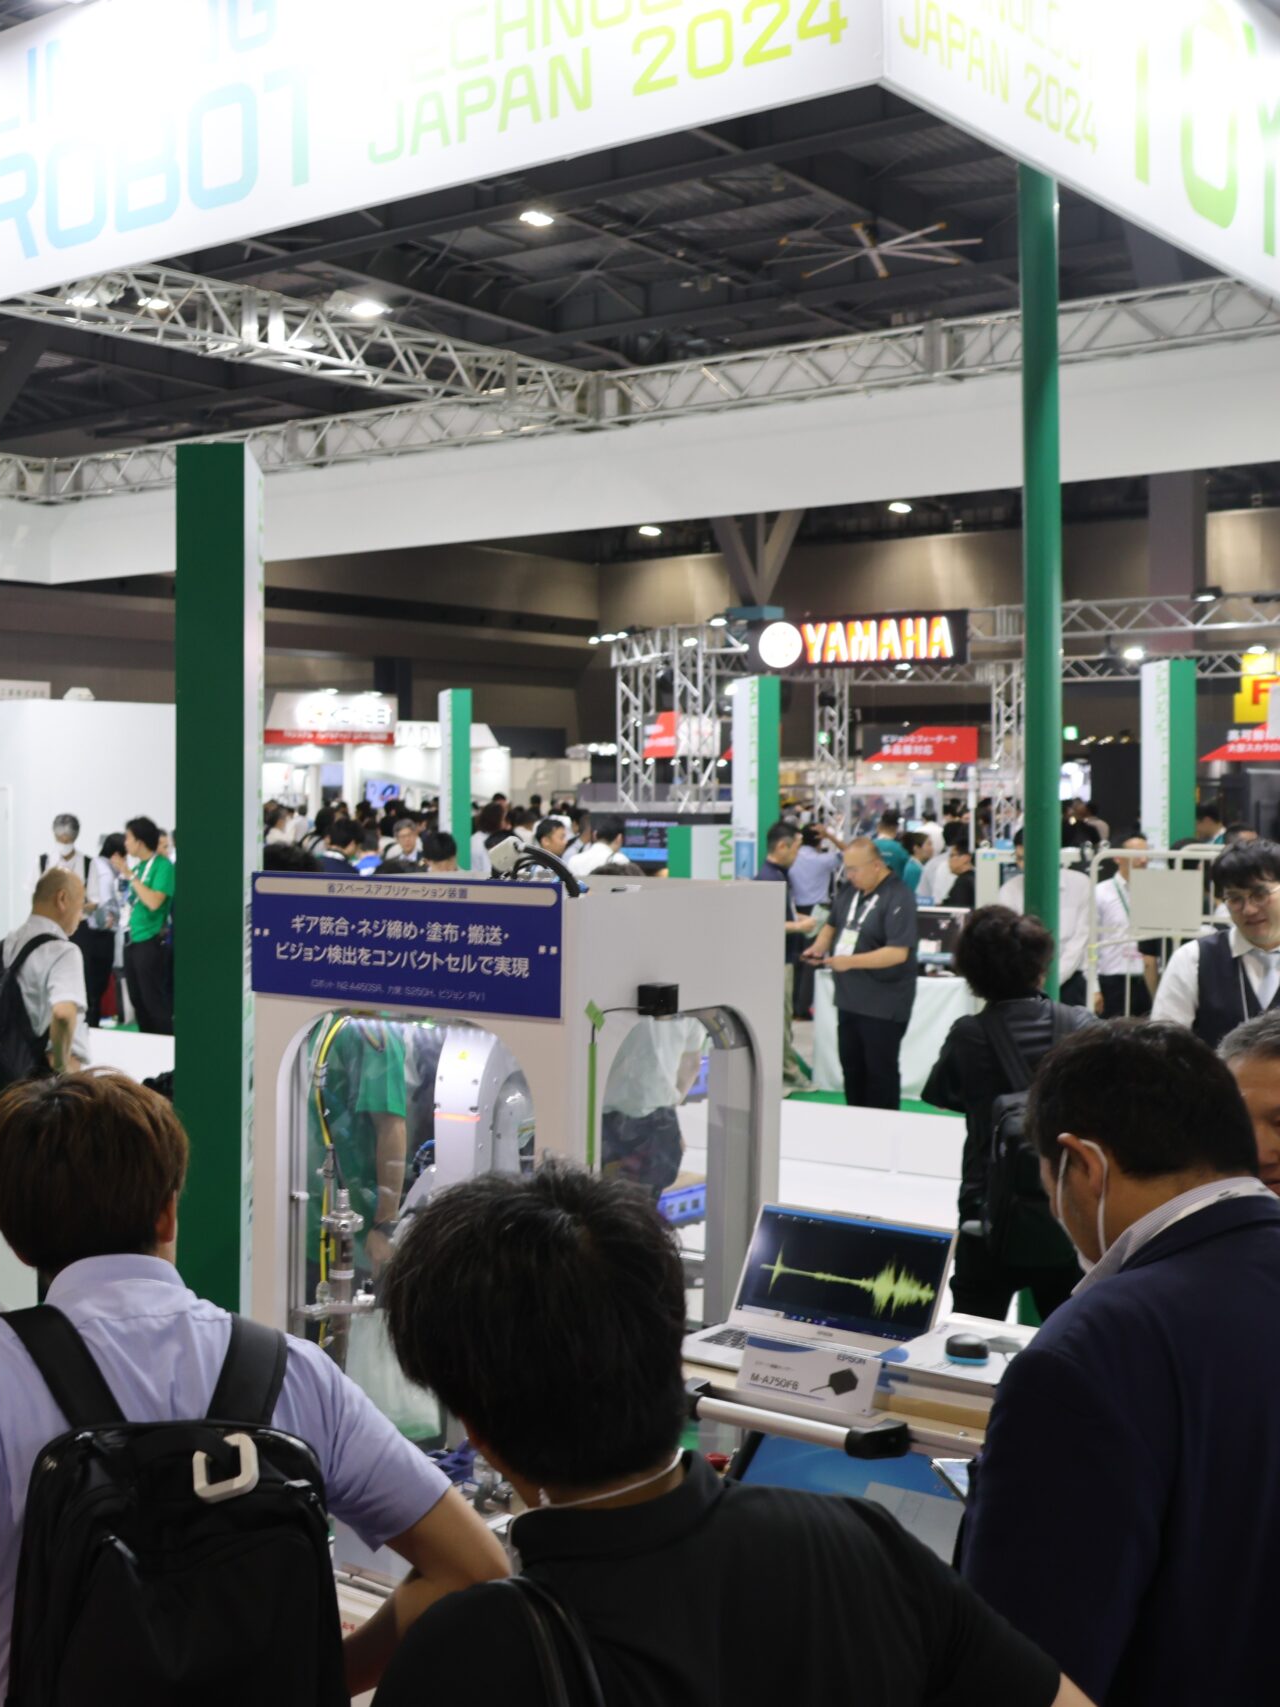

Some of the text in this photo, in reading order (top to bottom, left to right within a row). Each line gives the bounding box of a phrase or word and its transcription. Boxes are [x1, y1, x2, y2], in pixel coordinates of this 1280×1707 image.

[368, 46, 593, 165] JAPAN
[630, 0, 850, 97] 2024
[898, 0, 1009, 104] JAPAN
[1023, 62, 1099, 154] 2024
[801, 616, 954, 664] YAMAHA
[275, 941, 530, 978] ビジョン検出をコンパクトセルで実現
[836, 1352, 866, 1365] EPSON
